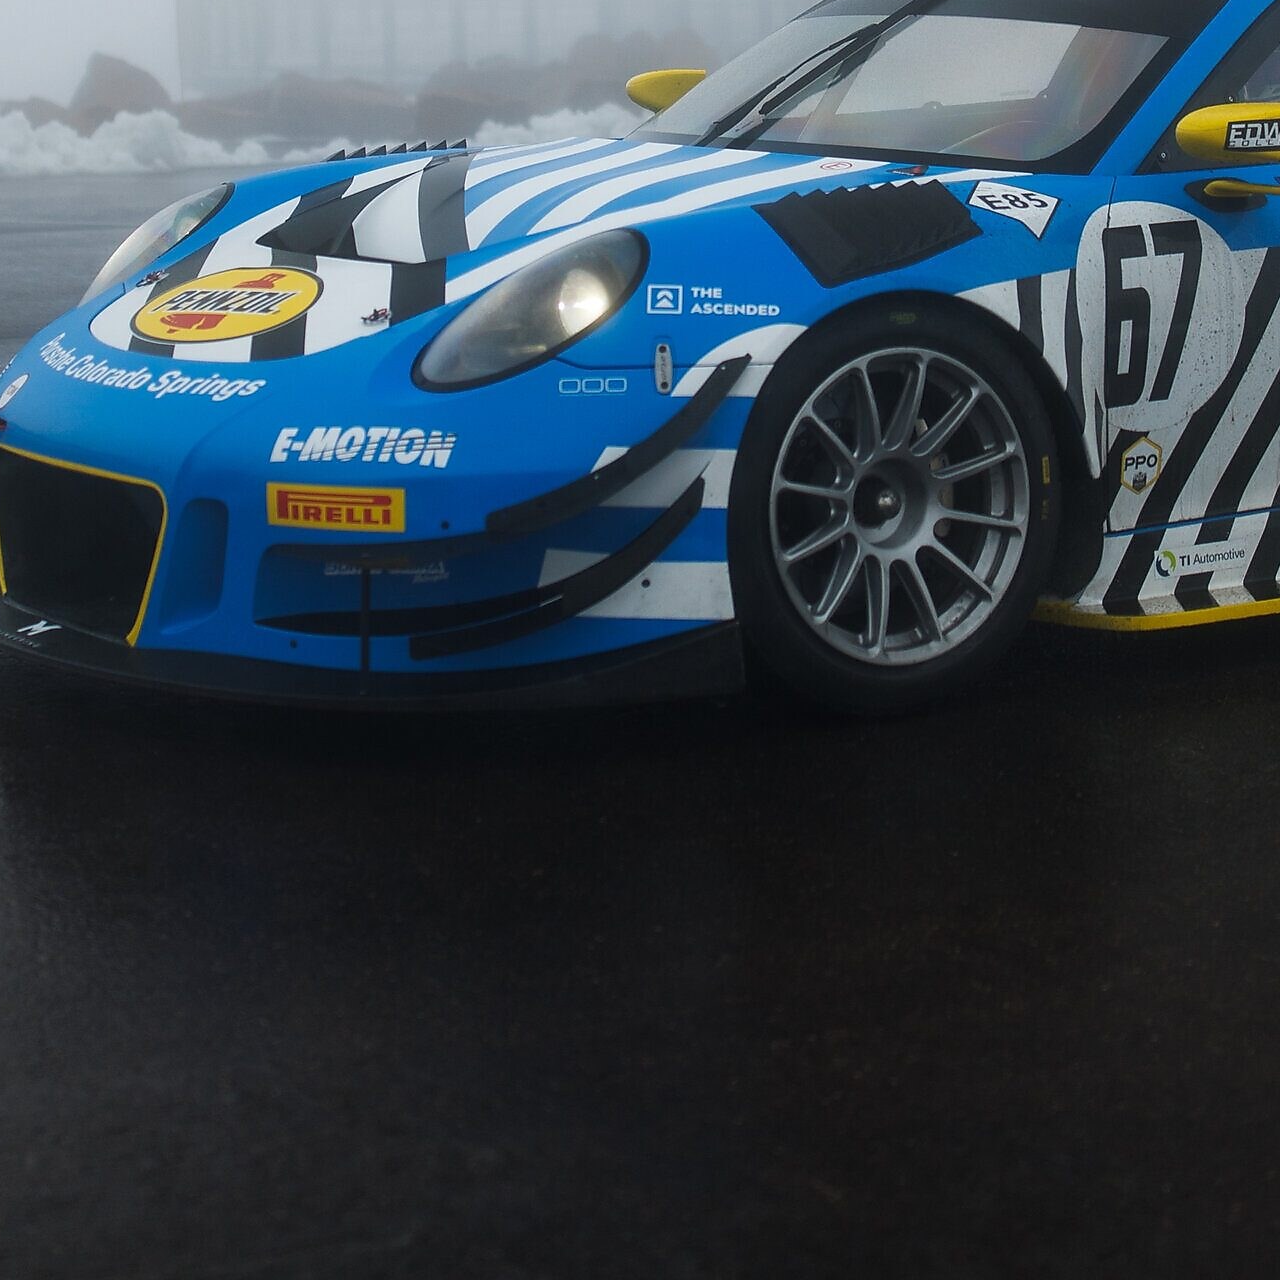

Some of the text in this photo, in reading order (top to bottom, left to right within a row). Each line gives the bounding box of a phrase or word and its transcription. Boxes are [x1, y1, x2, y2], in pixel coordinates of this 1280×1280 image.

[977, 192, 1049, 210] E85
[148, 288, 304, 318] PENNZOIL
[690, 286, 723, 299] THE
[690, 302, 781, 317] ASCENDED
[1102, 219, 1203, 410] 67
[40, 332, 78, 372] Porsche
[65, 354, 152, 391] Colorado
[147, 370, 267, 403] Springs
[269, 425, 458, 469] E-MOTION
[1124, 454, 1158, 471] PPO
[276, 489, 392, 526] PIRELLI
[1179, 547, 1245, 567] TI Automotive
